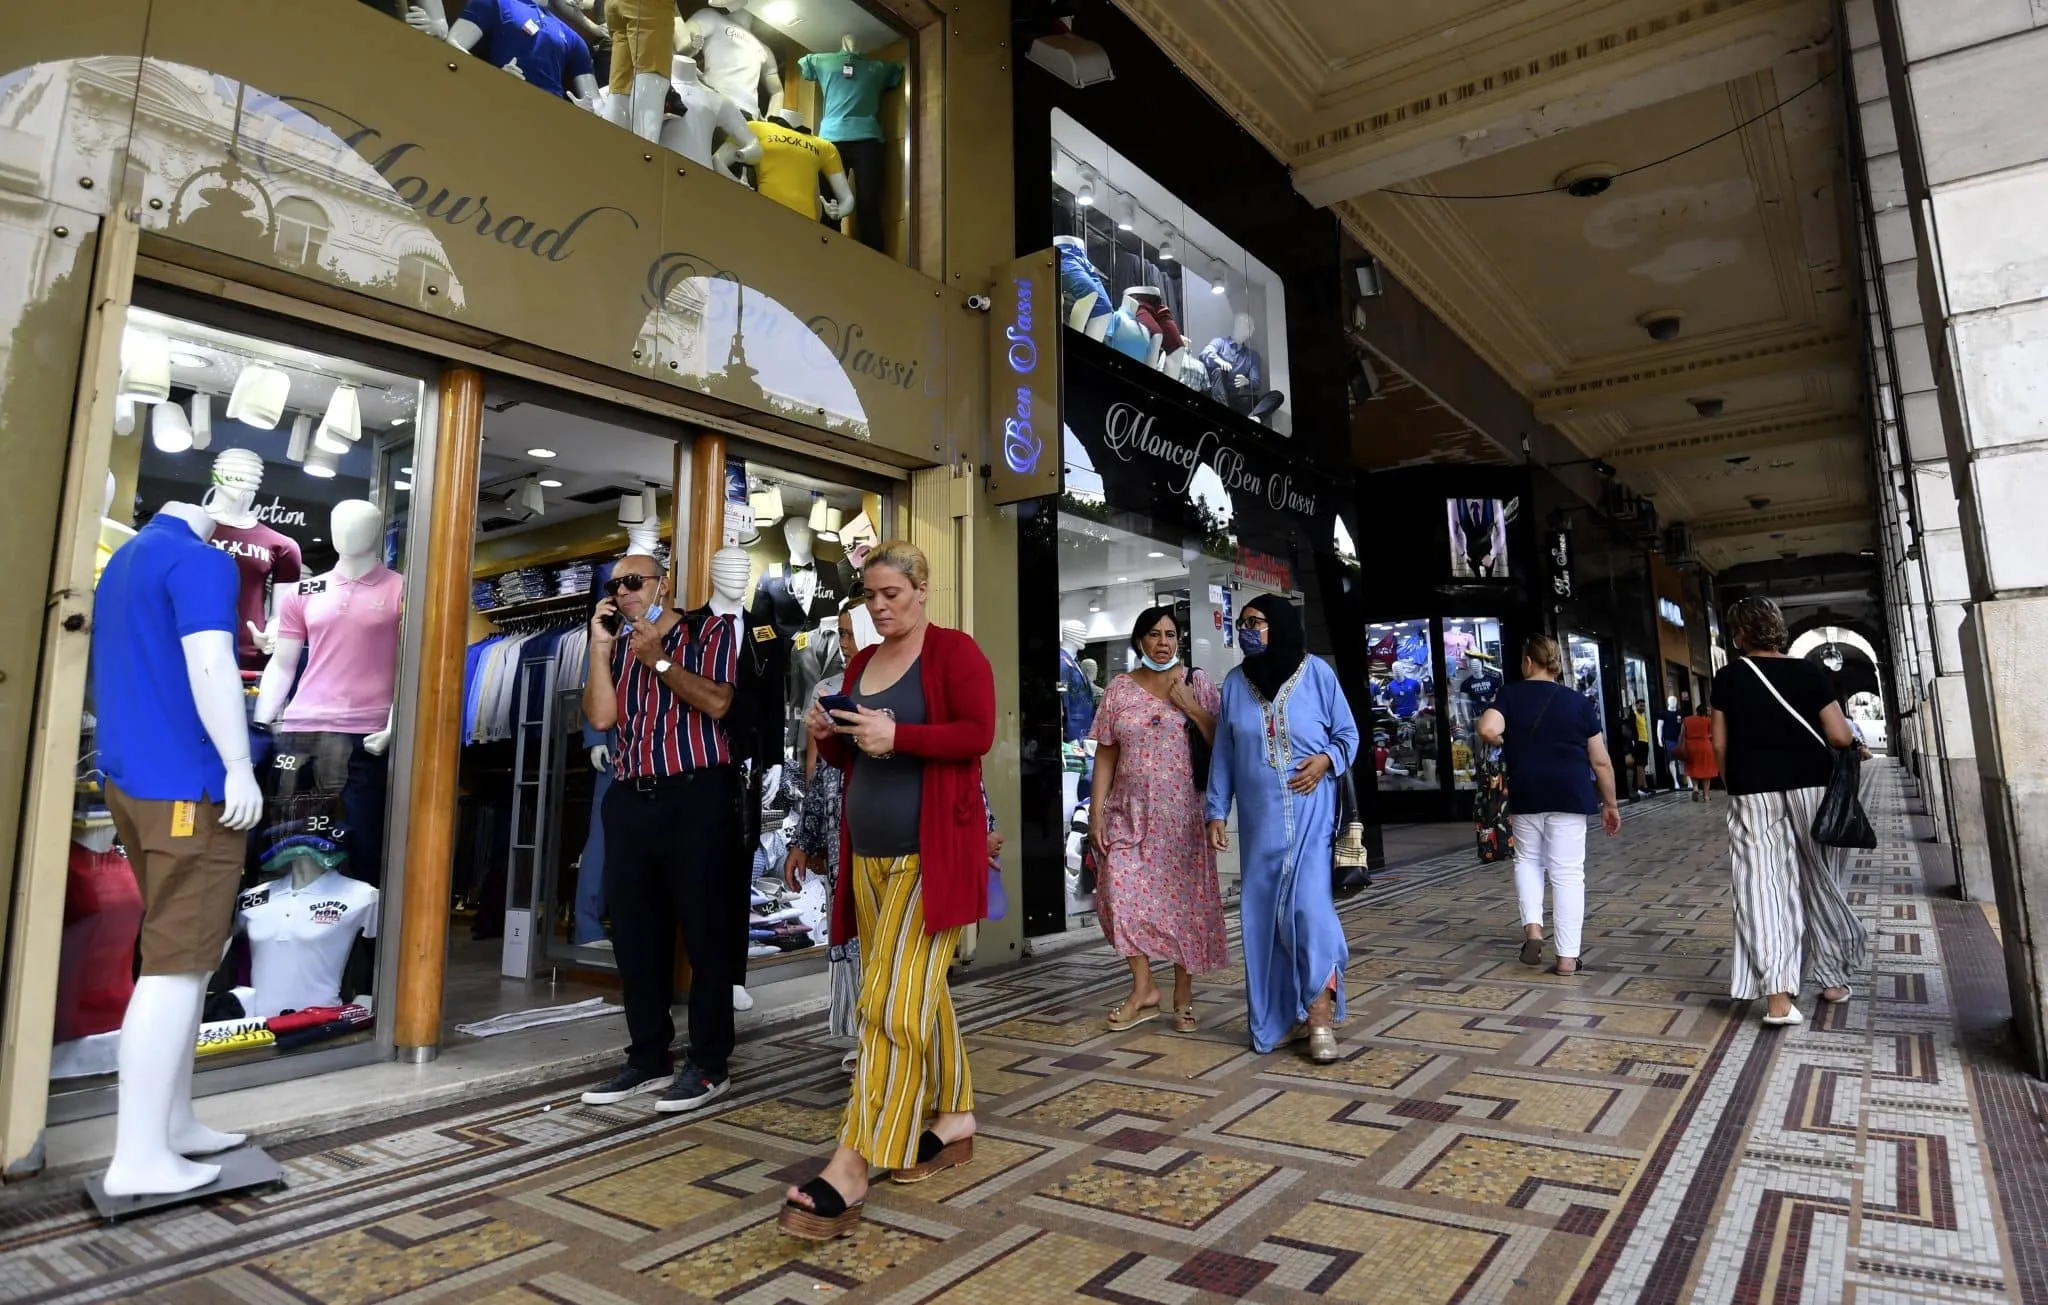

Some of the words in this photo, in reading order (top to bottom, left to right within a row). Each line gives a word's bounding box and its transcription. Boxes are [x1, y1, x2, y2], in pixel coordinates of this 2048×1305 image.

[224, 95, 639, 262] Mourad
[639, 252, 782, 338] Ben
[800, 315, 920, 391] Sassi
[1006, 277, 1038, 374] Sassi
[1004, 384, 1043, 475] Ben
[1103, 401, 1219, 494] Moncef
[1213, 446, 1263, 497] Ben
[1267, 472, 1318, 516] Sassi
[310, 901, 348, 912] SUPER
